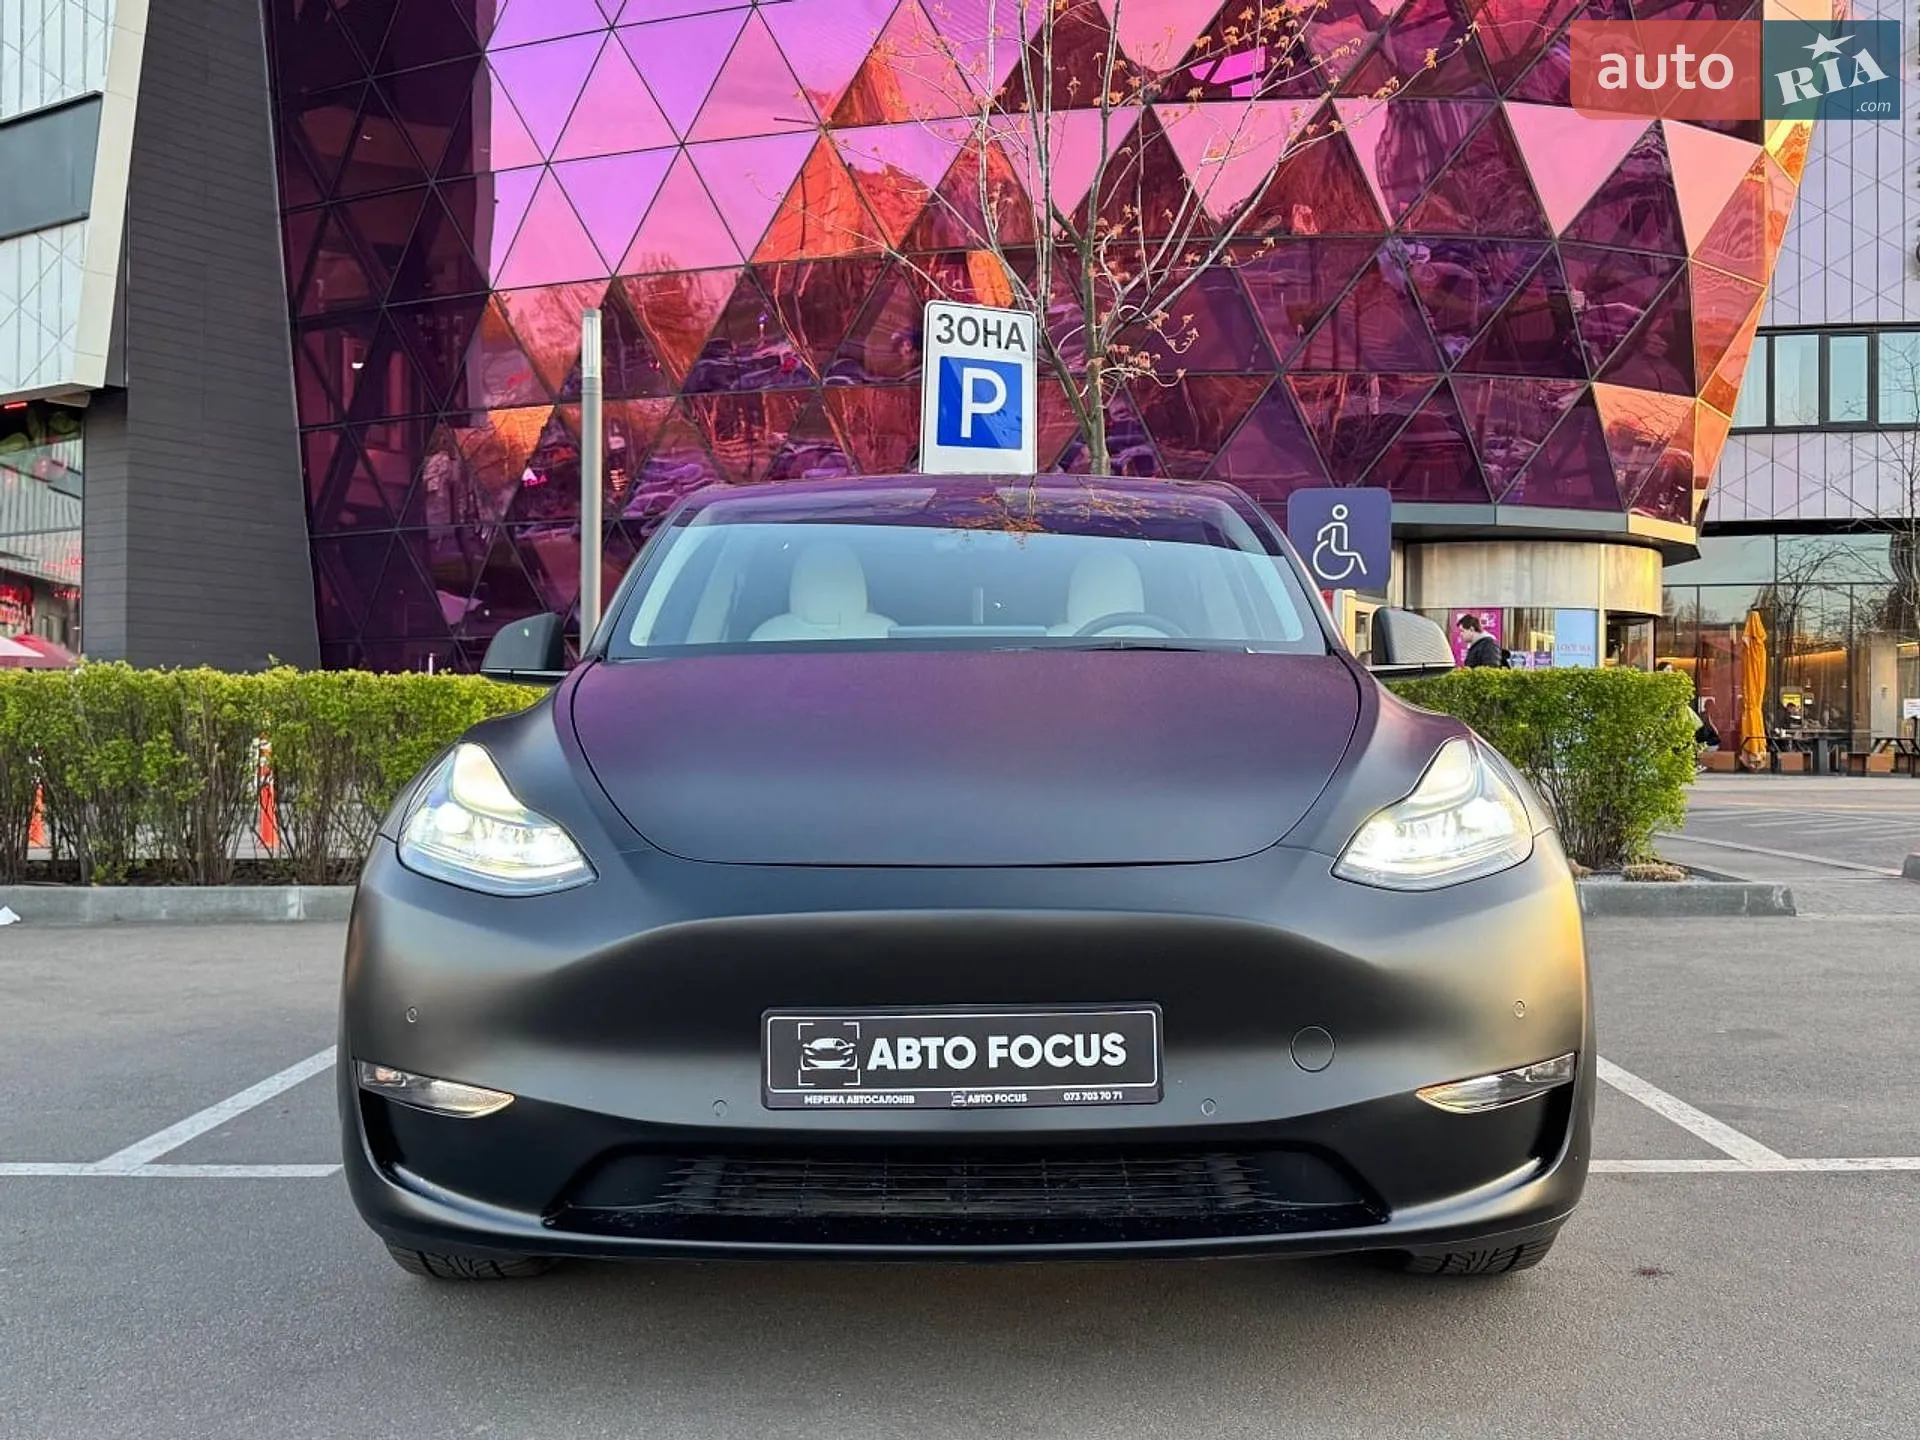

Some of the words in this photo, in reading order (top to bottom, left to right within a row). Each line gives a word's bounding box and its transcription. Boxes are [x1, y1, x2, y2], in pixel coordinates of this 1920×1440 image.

[936, 313, 1026, 352] ЗОНА
[960, 367, 1007, 439] P
[867, 1035, 976, 1071] АВТО
[988, 1033, 1127, 1069] FOCUS
[804, 1094, 844, 1105] МЕРЕЖА
[846, 1094, 915, 1104] АВТОСАЛОНІВ
[994, 1093, 1028, 1103] FOCUS
